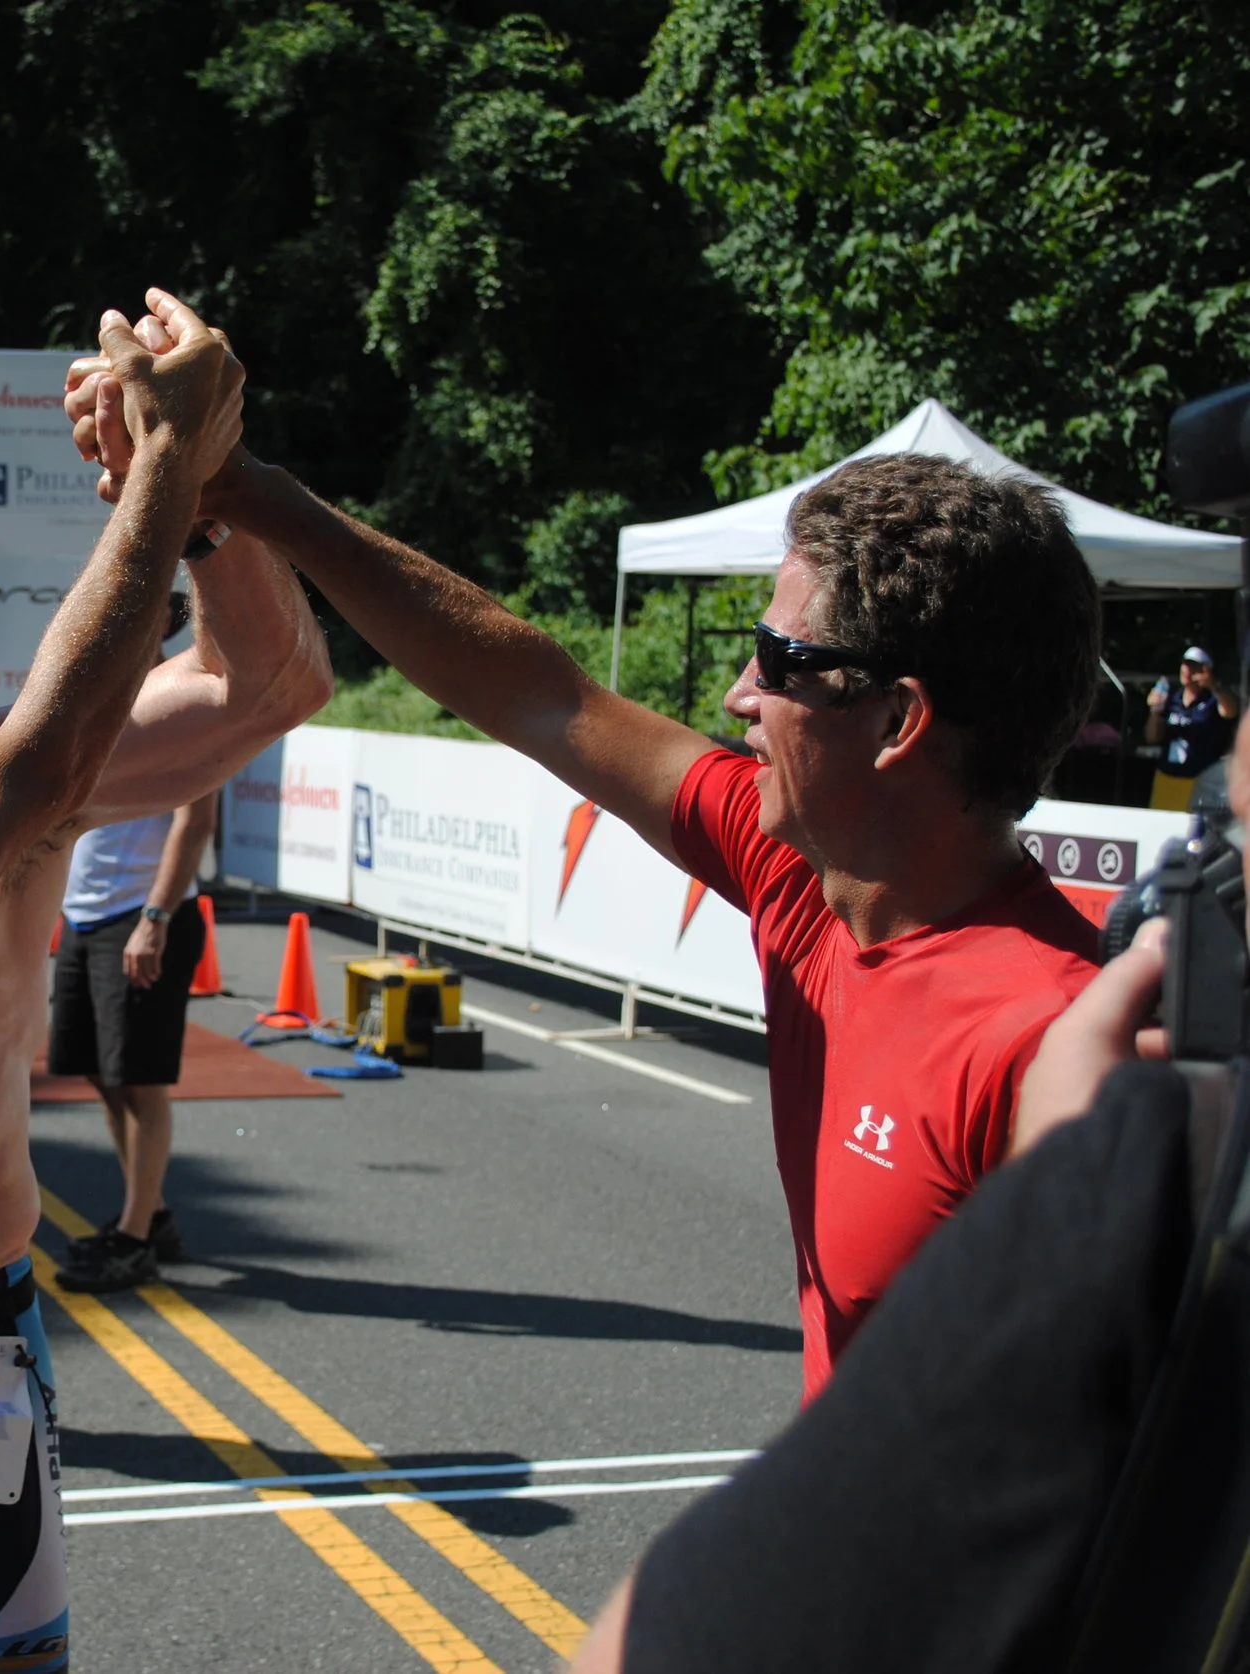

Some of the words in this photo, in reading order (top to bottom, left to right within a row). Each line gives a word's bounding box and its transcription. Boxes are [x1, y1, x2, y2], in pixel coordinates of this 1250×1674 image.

[375, 792, 521, 859] PHILADELPHIA
[843, 1138, 864, 1156] UNDER
[862, 1150, 894, 1169] ARMOUR
